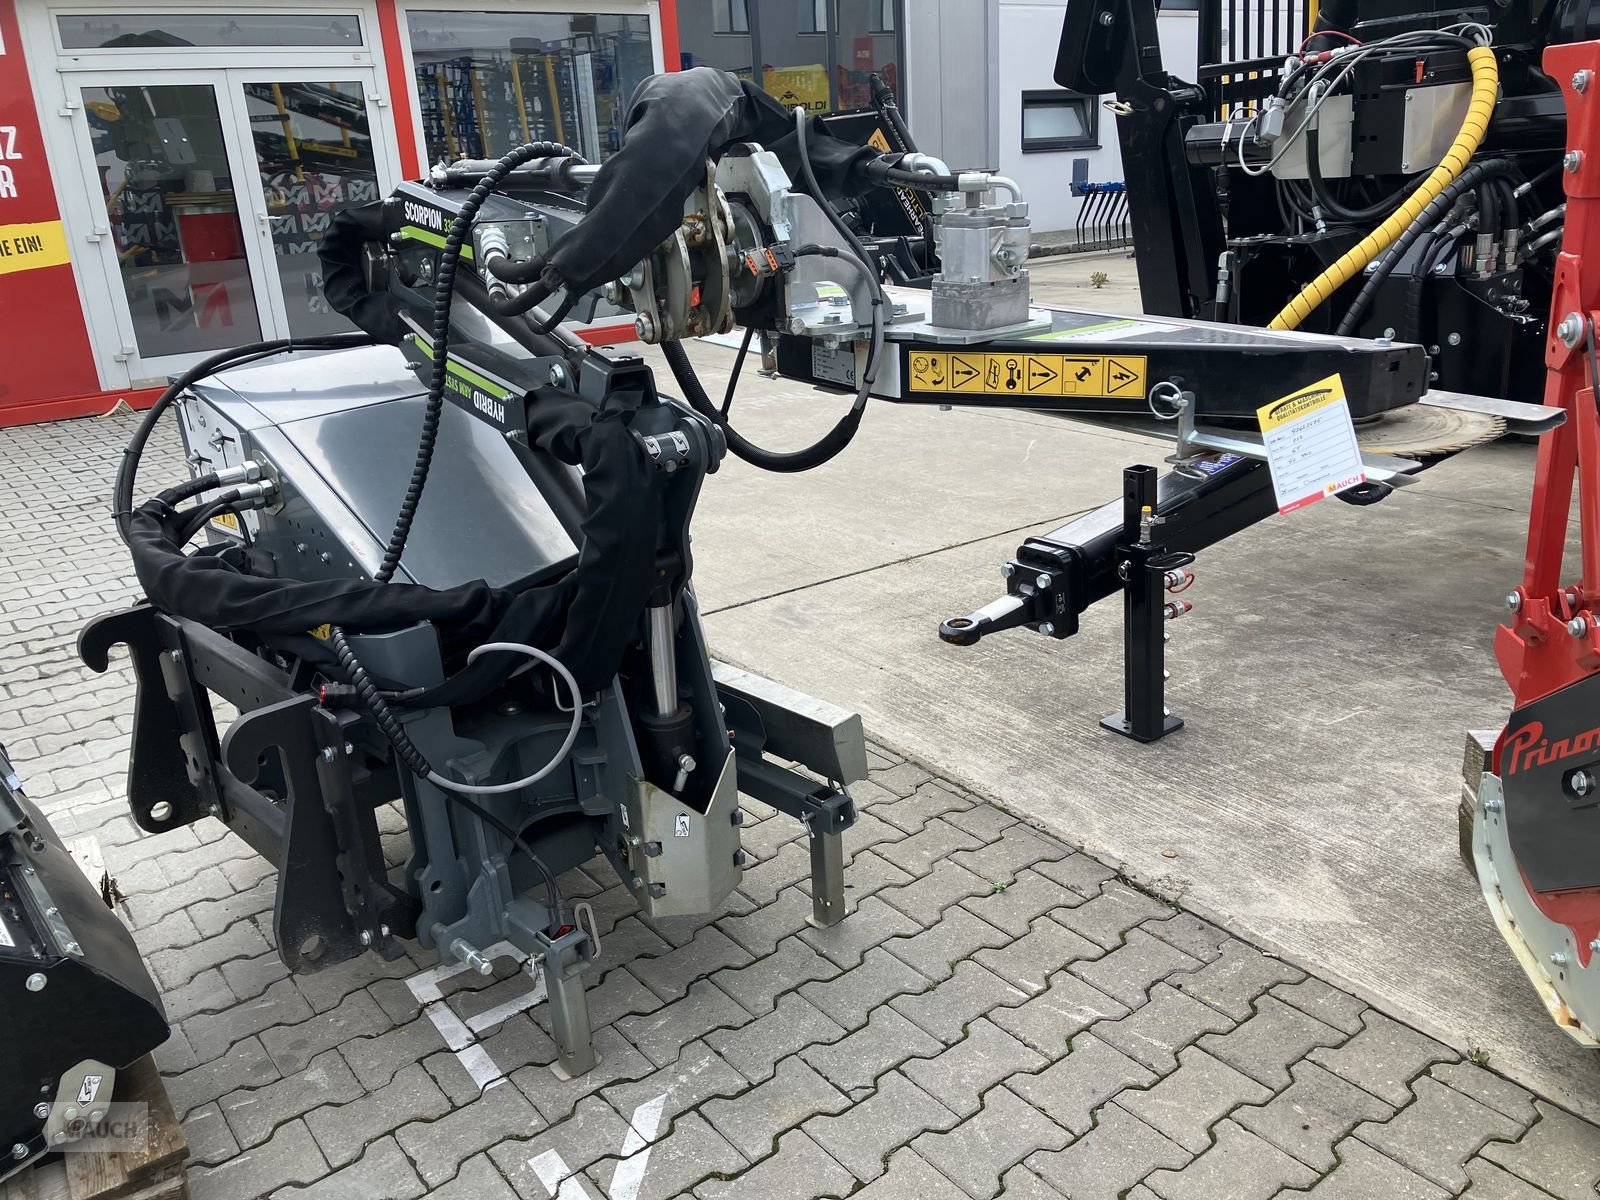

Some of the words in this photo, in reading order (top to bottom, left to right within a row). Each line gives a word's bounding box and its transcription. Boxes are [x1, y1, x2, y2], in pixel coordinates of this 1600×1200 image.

[0, 126, 23, 159] Z
[404, 200, 442, 231] SCORPION
[13, 235, 43, 255] EIN!
[445, 374, 458, 392] SYST
[459, 381, 472, 399] ARM
[473, 390, 505, 424] HYBRID
[1328, 476, 1359, 492] MAUCH
